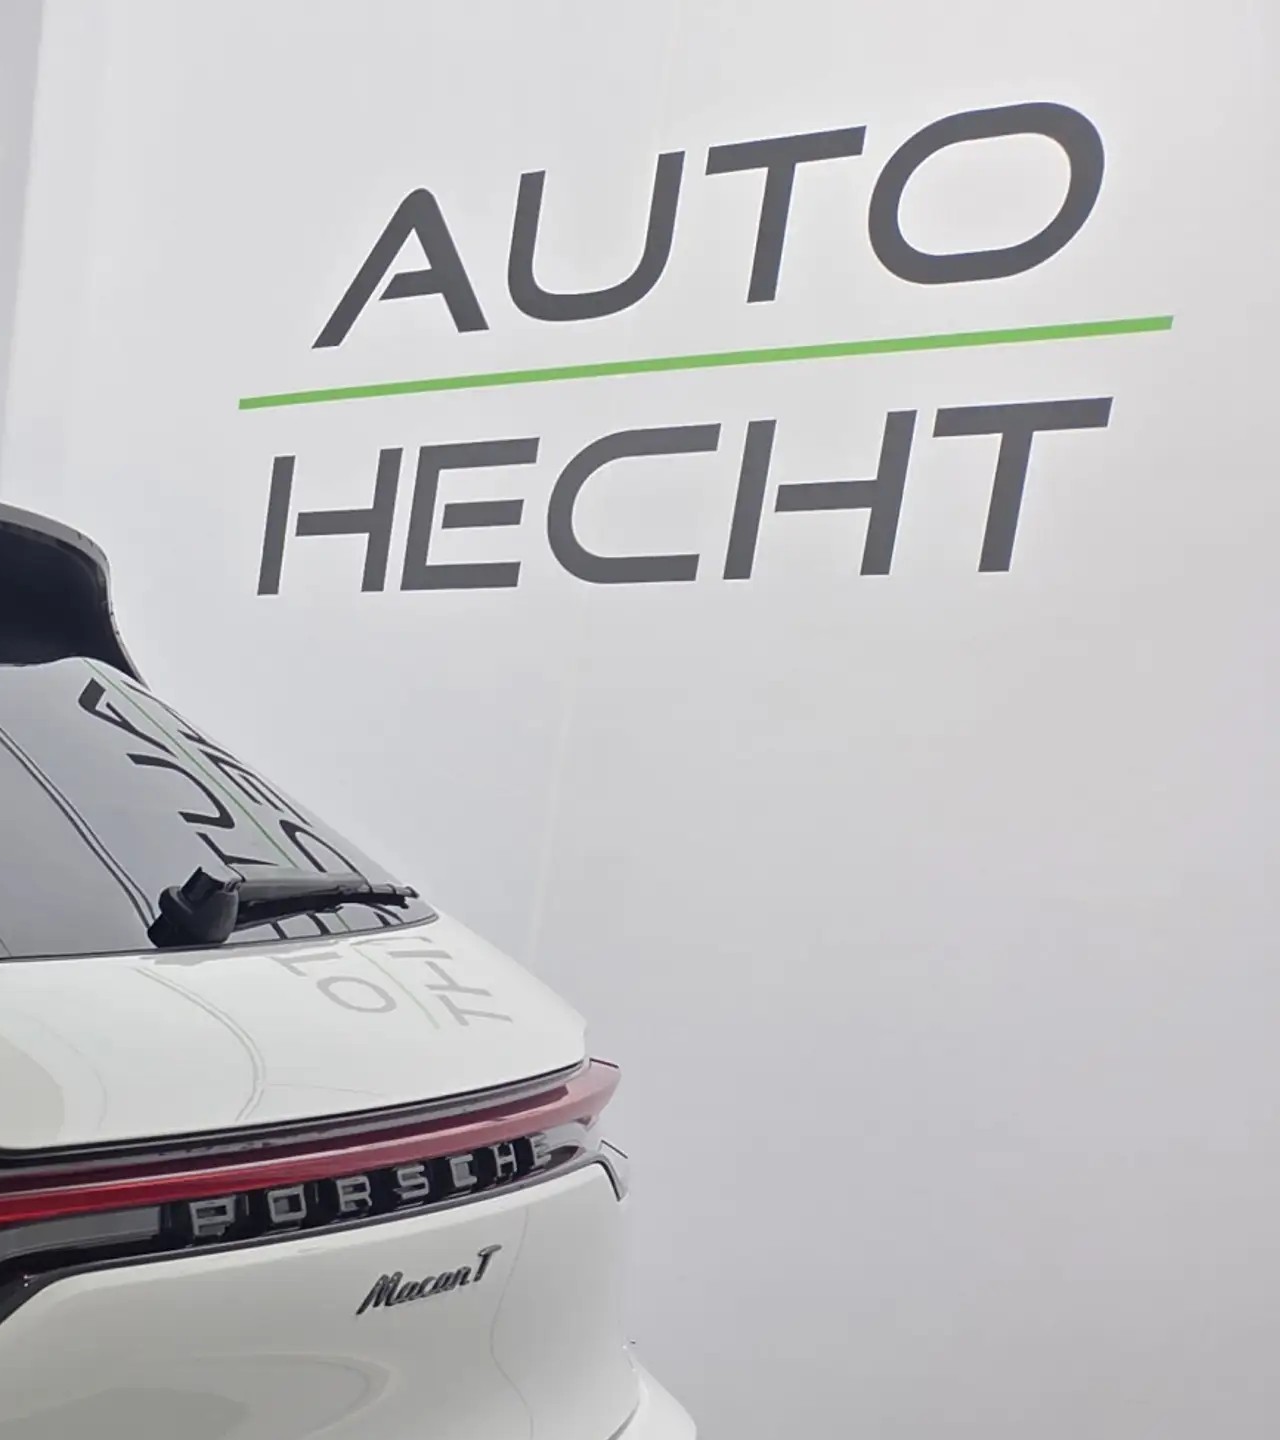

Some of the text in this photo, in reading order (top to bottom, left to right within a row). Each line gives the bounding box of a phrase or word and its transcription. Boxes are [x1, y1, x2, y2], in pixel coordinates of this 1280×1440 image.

[311, 101, 1104, 350] AUTO
[256, 397, 1113, 596] HECHT
[354, 1244, 503, 1316] Macan T
